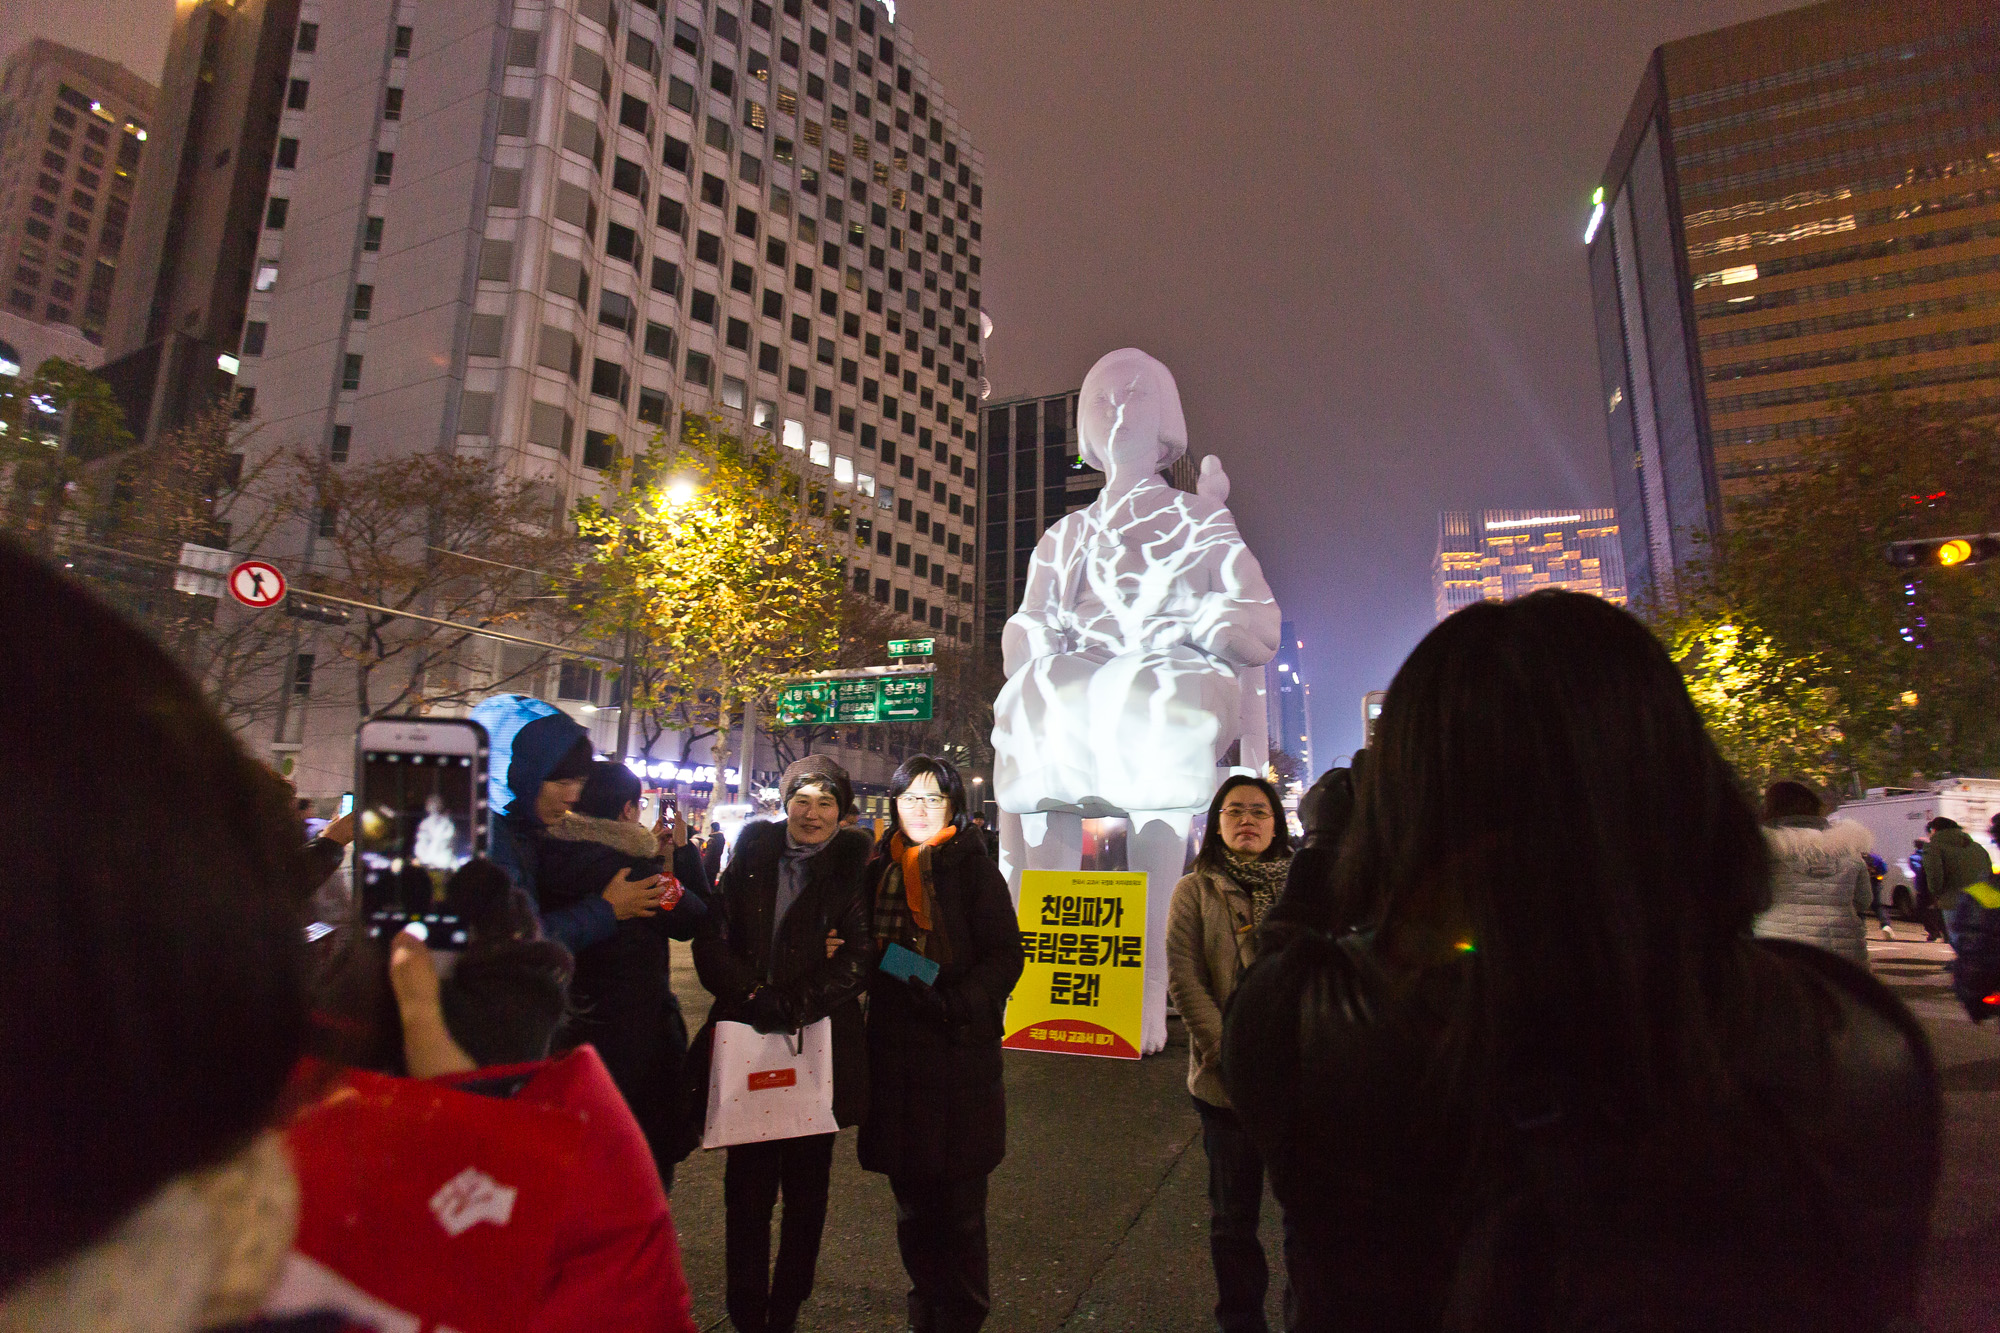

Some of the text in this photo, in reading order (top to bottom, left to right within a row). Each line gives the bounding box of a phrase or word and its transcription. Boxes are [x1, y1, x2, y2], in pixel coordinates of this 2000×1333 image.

[884, 682, 926, 695] 종로구청
[1041, 895, 1123, 928] 친일파가
[1019, 930, 1142, 968] 독립운동가로
[1051, 972, 1100, 1006] 둔갑!
[1029, 1028, 1048, 1041] 국정
[1048, 1029, 1067, 1042] 역사
[1067, 1031, 1094, 1044] 교과서
